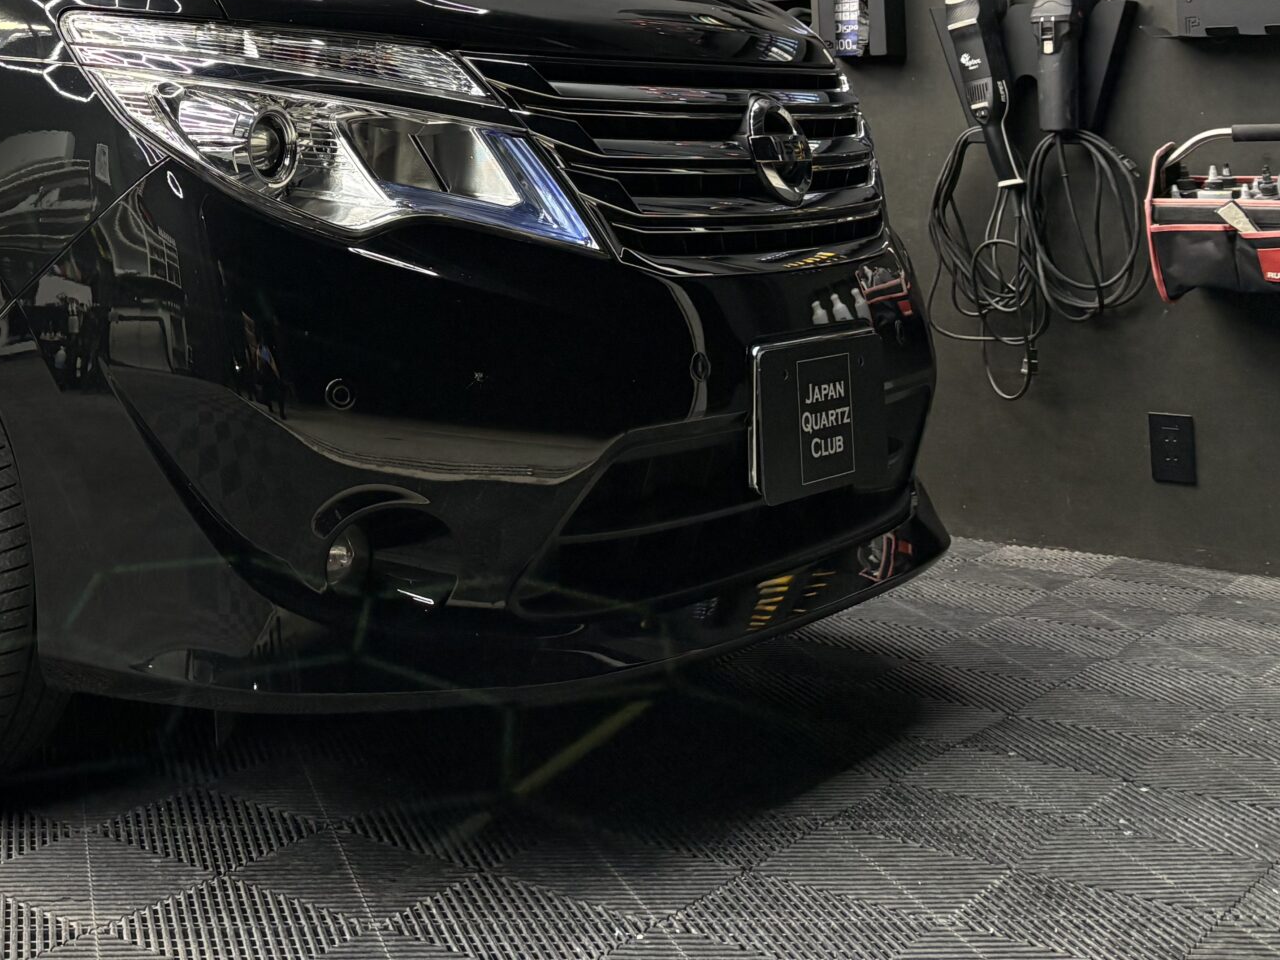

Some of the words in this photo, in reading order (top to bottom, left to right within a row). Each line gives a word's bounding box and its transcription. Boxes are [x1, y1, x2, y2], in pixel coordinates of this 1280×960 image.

[806, 381, 844, 404] JAPAN
[802, 406, 850, 434] QUARTZ
[811, 436, 844, 458] CLUB
